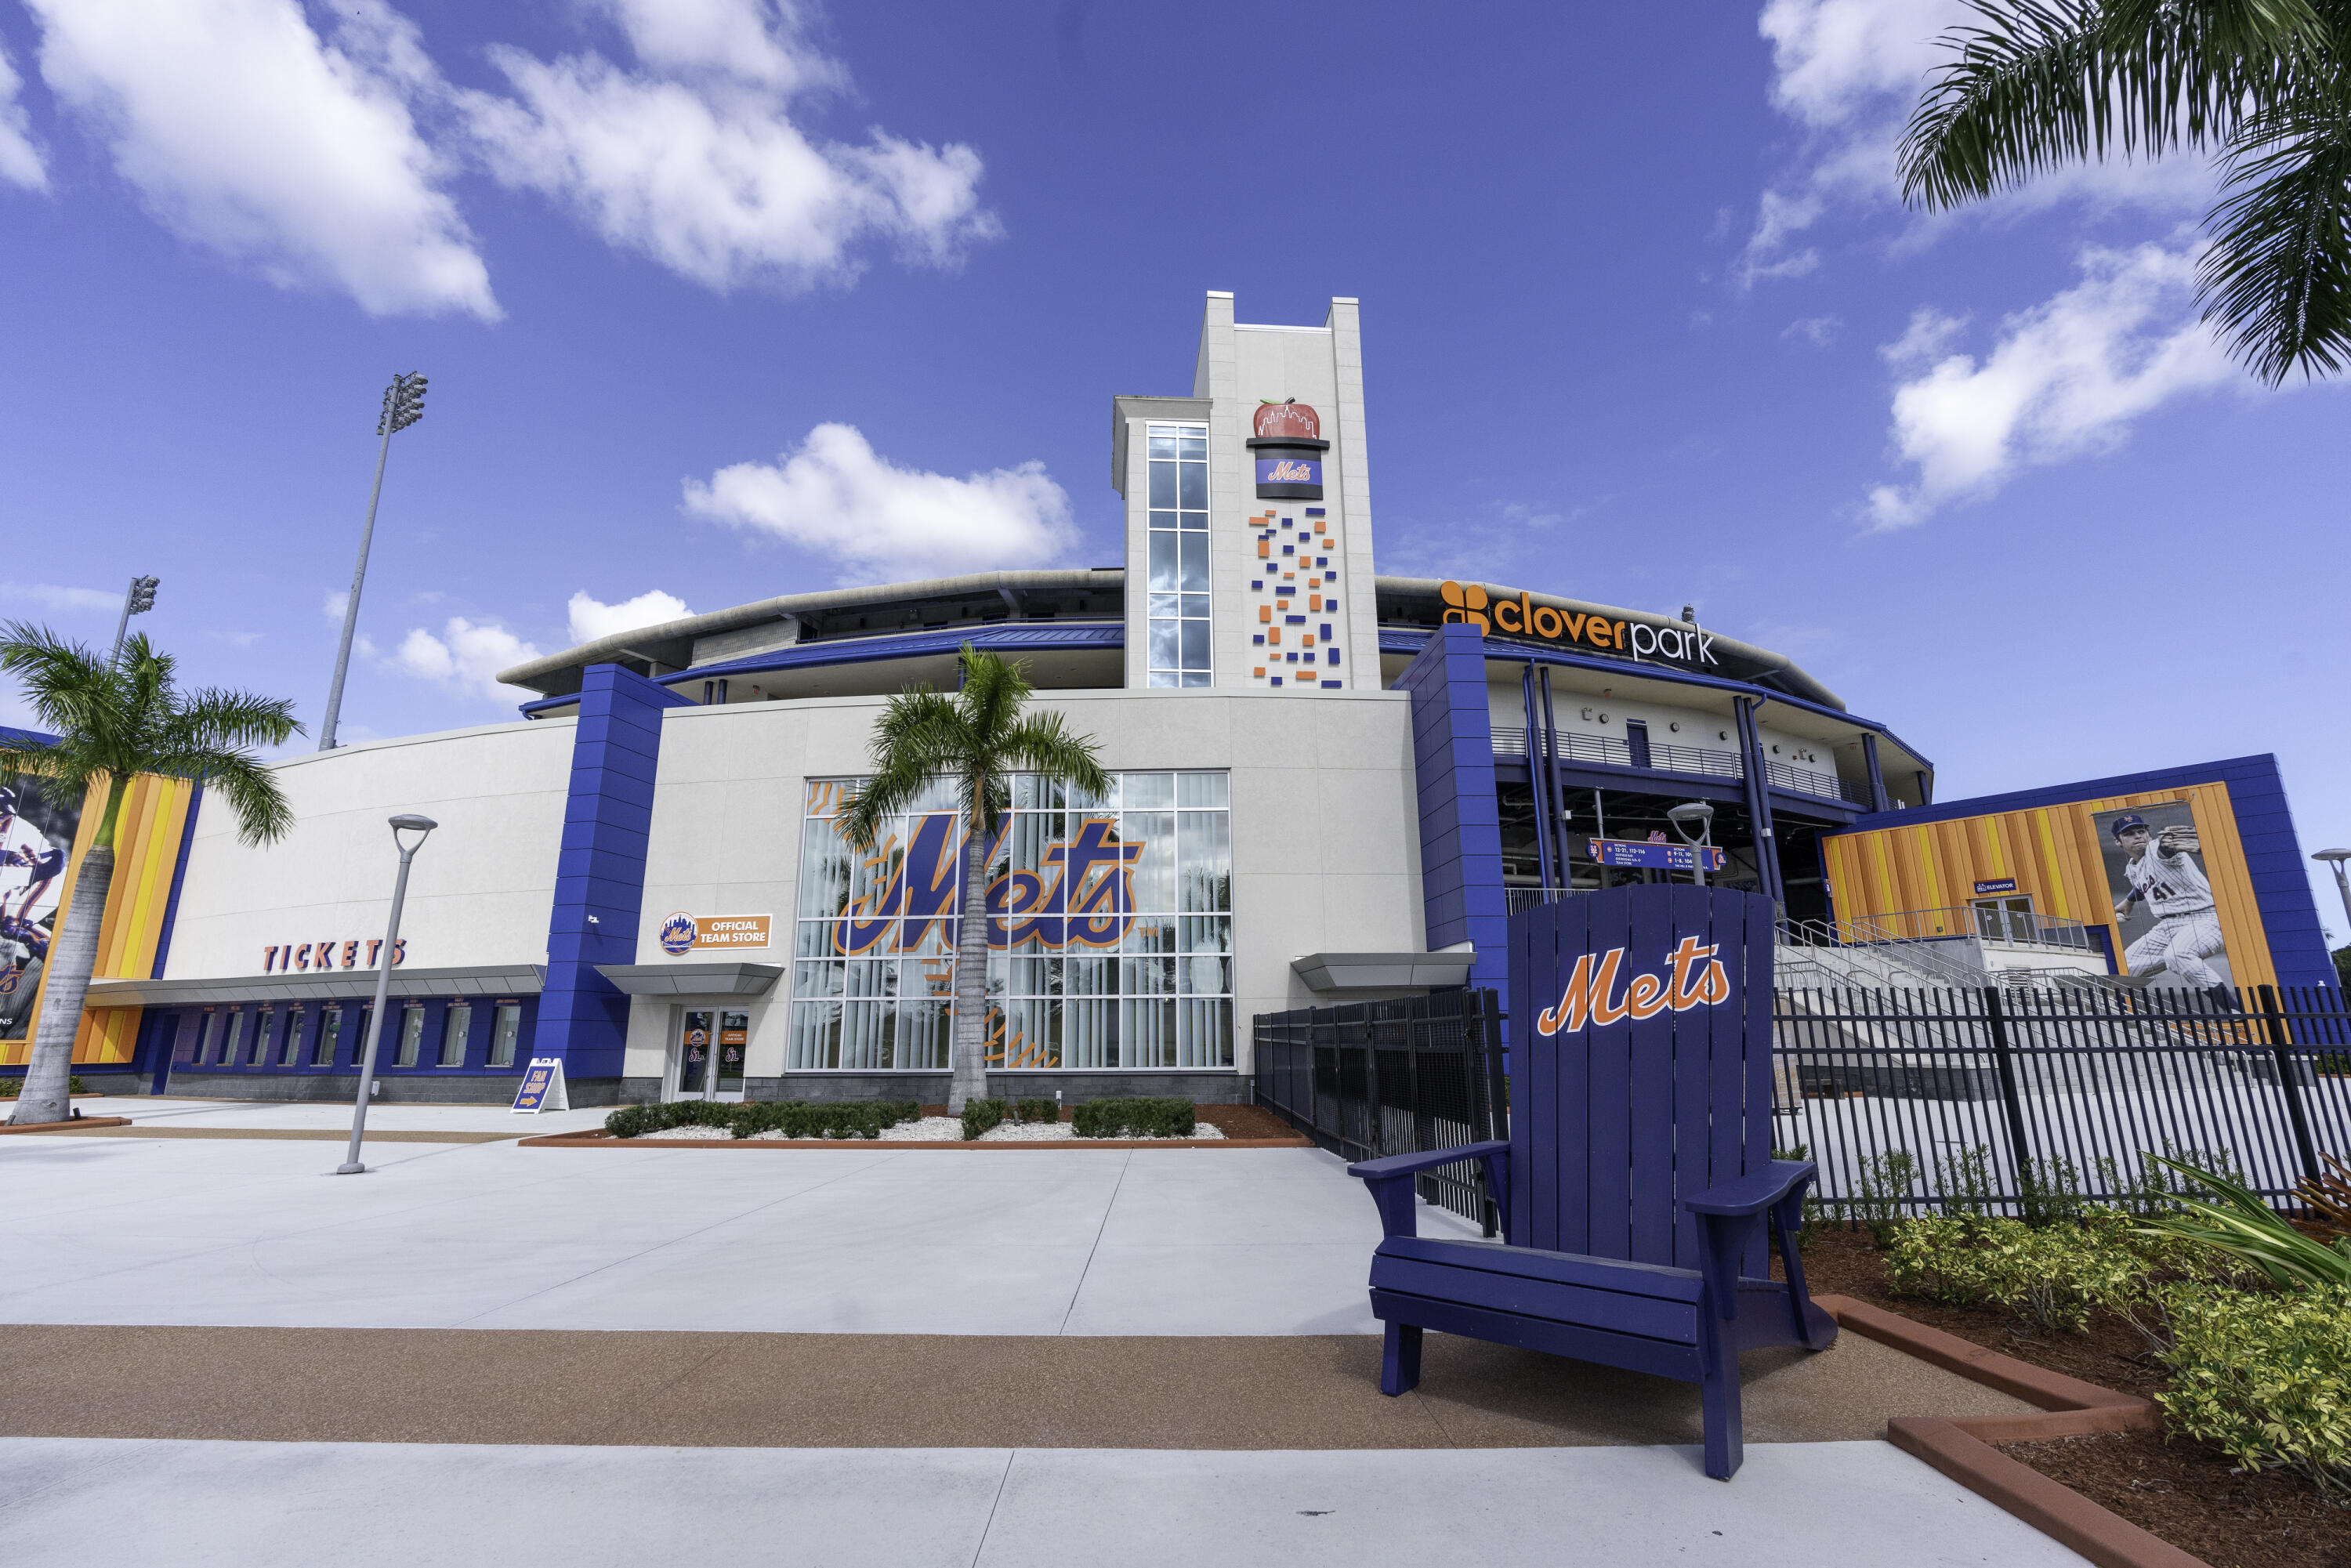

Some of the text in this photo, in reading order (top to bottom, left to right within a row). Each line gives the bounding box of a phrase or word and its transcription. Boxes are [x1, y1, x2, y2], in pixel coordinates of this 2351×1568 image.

[1268, 461, 1310, 481] Mets
[832, 809, 1147, 955] Mets
[2153, 882, 2176, 900] 41
[665, 927, 692, 942] Mets
[711, 921, 759, 932] OFFICIAL
[700, 932, 766, 943] TEAM STORE
[263, 939, 408, 971] TICKETS
[1537, 935, 1730, 1037] Mets
[531, 1070, 548, 1082] FAN
[523, 1082, 546, 1094] SHOP
